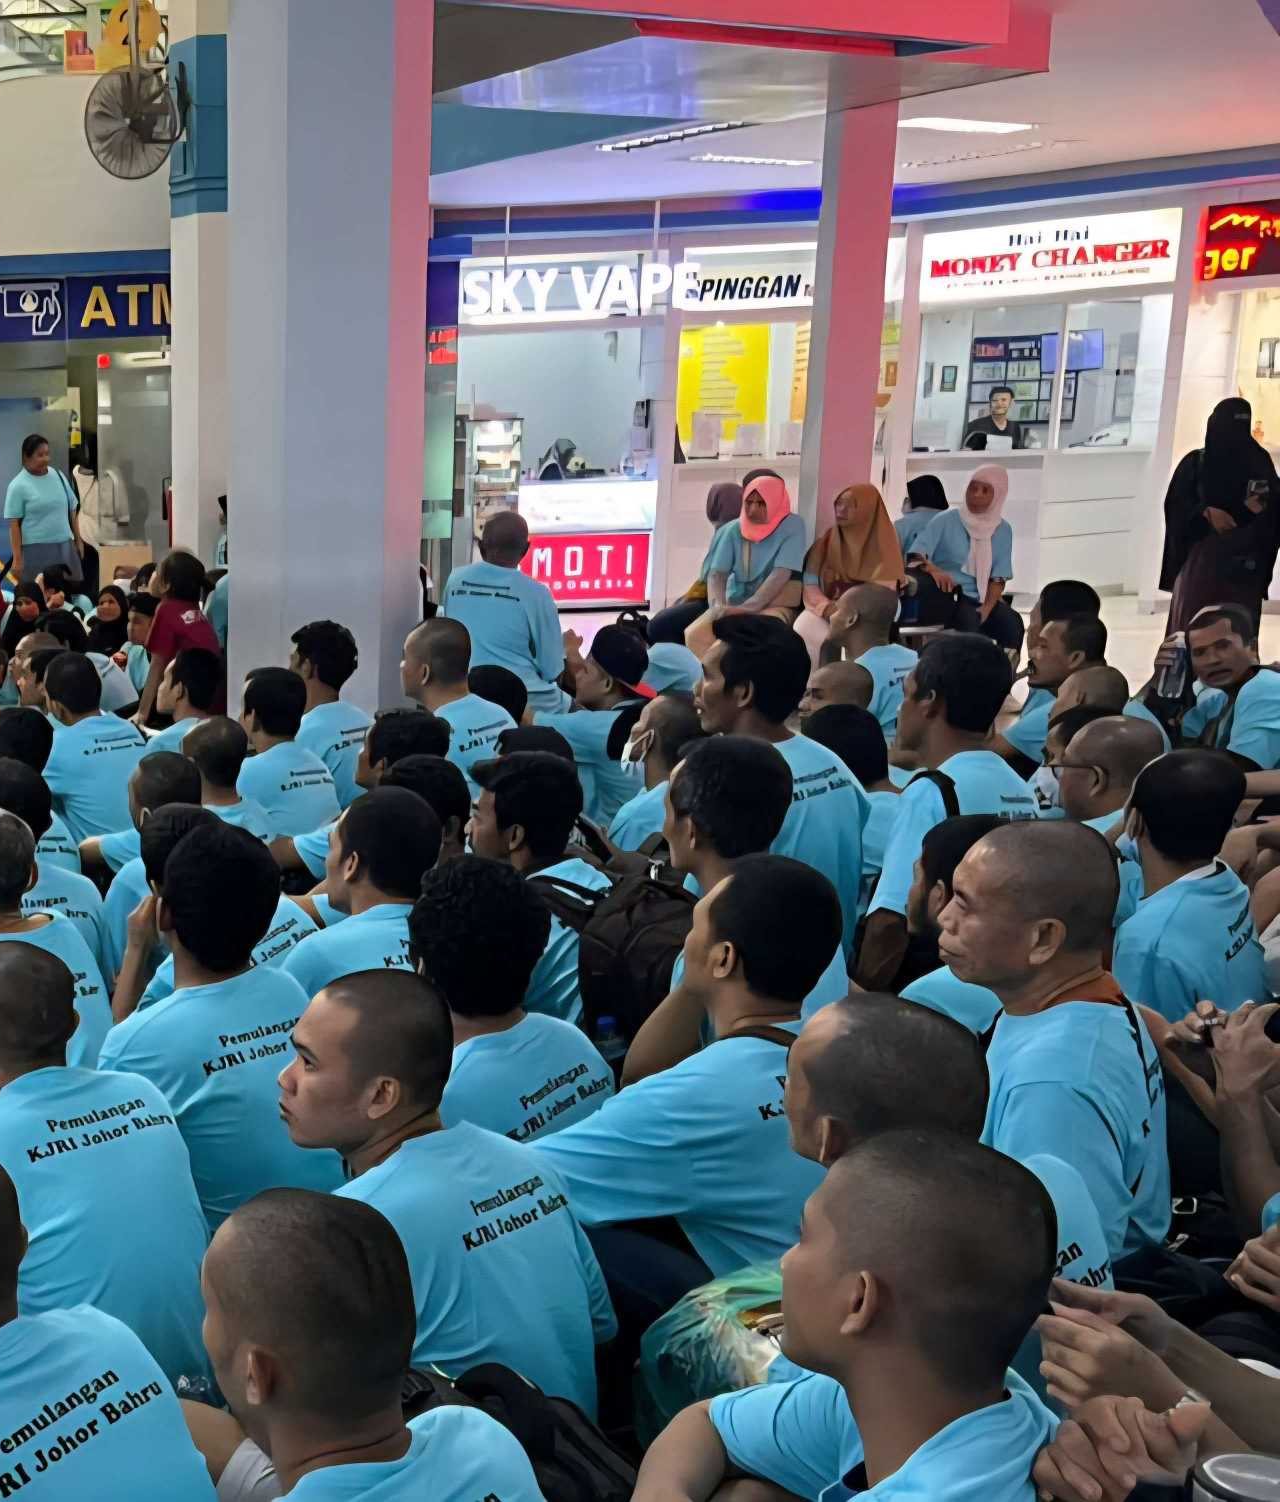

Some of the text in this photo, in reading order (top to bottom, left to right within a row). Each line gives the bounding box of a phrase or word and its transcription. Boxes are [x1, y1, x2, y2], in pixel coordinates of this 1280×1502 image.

[930, 252, 1022, 278] MONEY
[1031, 239, 1170, 268] CHANGER
[463, 262, 701, 317] SKY VAPE
[698, 274, 801, 302] PINGGAN
[531, 544, 634, 577] MOTI
[546, 579, 635, 591] DONESIA
[218, 1016, 300, 1049] Pemulanga
[201, 1040, 289, 1077] KJRI Johor
[46, 1097, 146, 1133] Pemulangan
[27, 1138, 79, 1164] KJRI
[81, 1122, 131, 1148] Johor
[34, 1418, 100, 1473] Johor
[99, 1380, 164, 1425] Bahru
